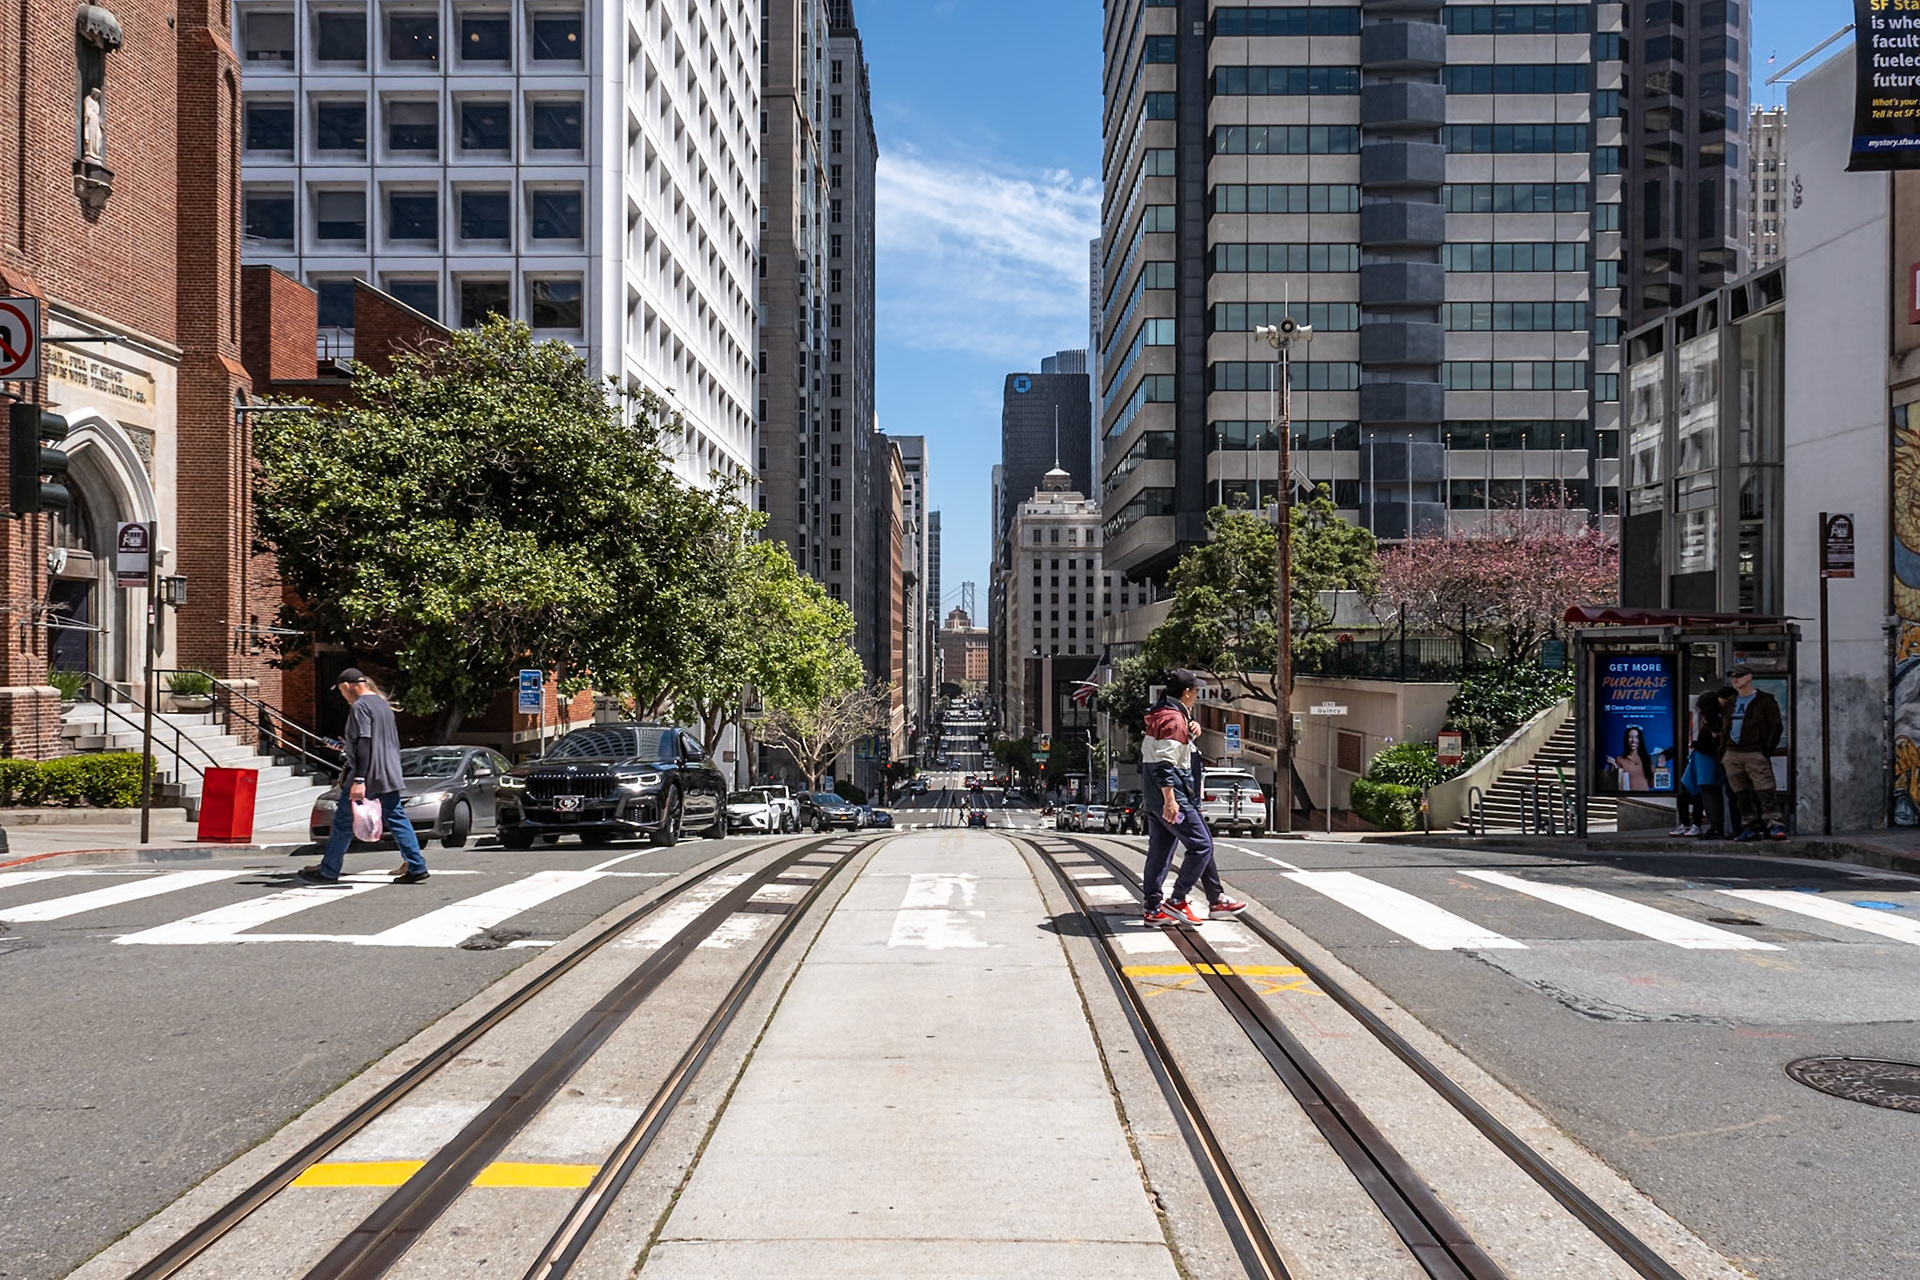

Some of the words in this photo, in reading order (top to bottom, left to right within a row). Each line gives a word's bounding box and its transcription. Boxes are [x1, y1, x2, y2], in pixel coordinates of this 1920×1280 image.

[1871, 0, 1889, 10] SF
[1871, 15, 1885, 29] is
[1872, 34, 1920, 48] facult
[1872, 98, 1899, 107] What's
[1899, 99, 1919, 107] your
[1872, 110, 1886, 118] Tell
[1886, 110, 1893, 118] it
[1893, 110, 1903, 118] at
[1904, 109, 1915, 117] SF
[1609, 663, 1629, 671] GET
[1632, 663, 1662, 671] MORE
[1602, 676, 1669, 688] PURCHASE
[1156, 688, 1232, 700] PING
[1612, 688, 1660, 700] INTENT
